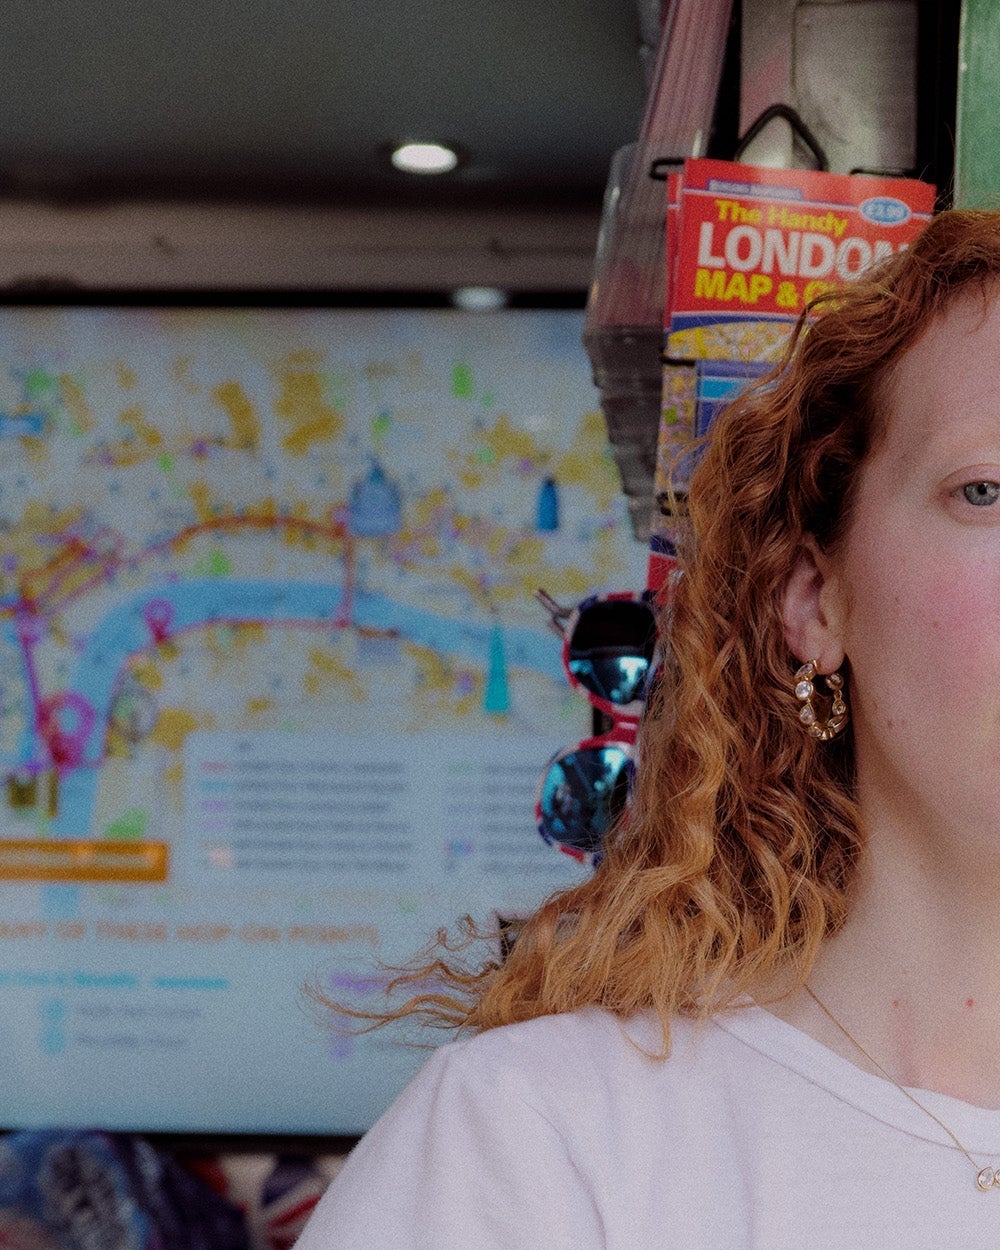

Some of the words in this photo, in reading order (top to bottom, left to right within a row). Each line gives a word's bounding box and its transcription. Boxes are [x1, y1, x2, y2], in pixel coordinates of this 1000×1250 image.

[715, 199, 762, 224] The
[767, 205, 848, 238] Handy
[694, 268, 774, 304] MAP
[776, 280, 799, 308] &
